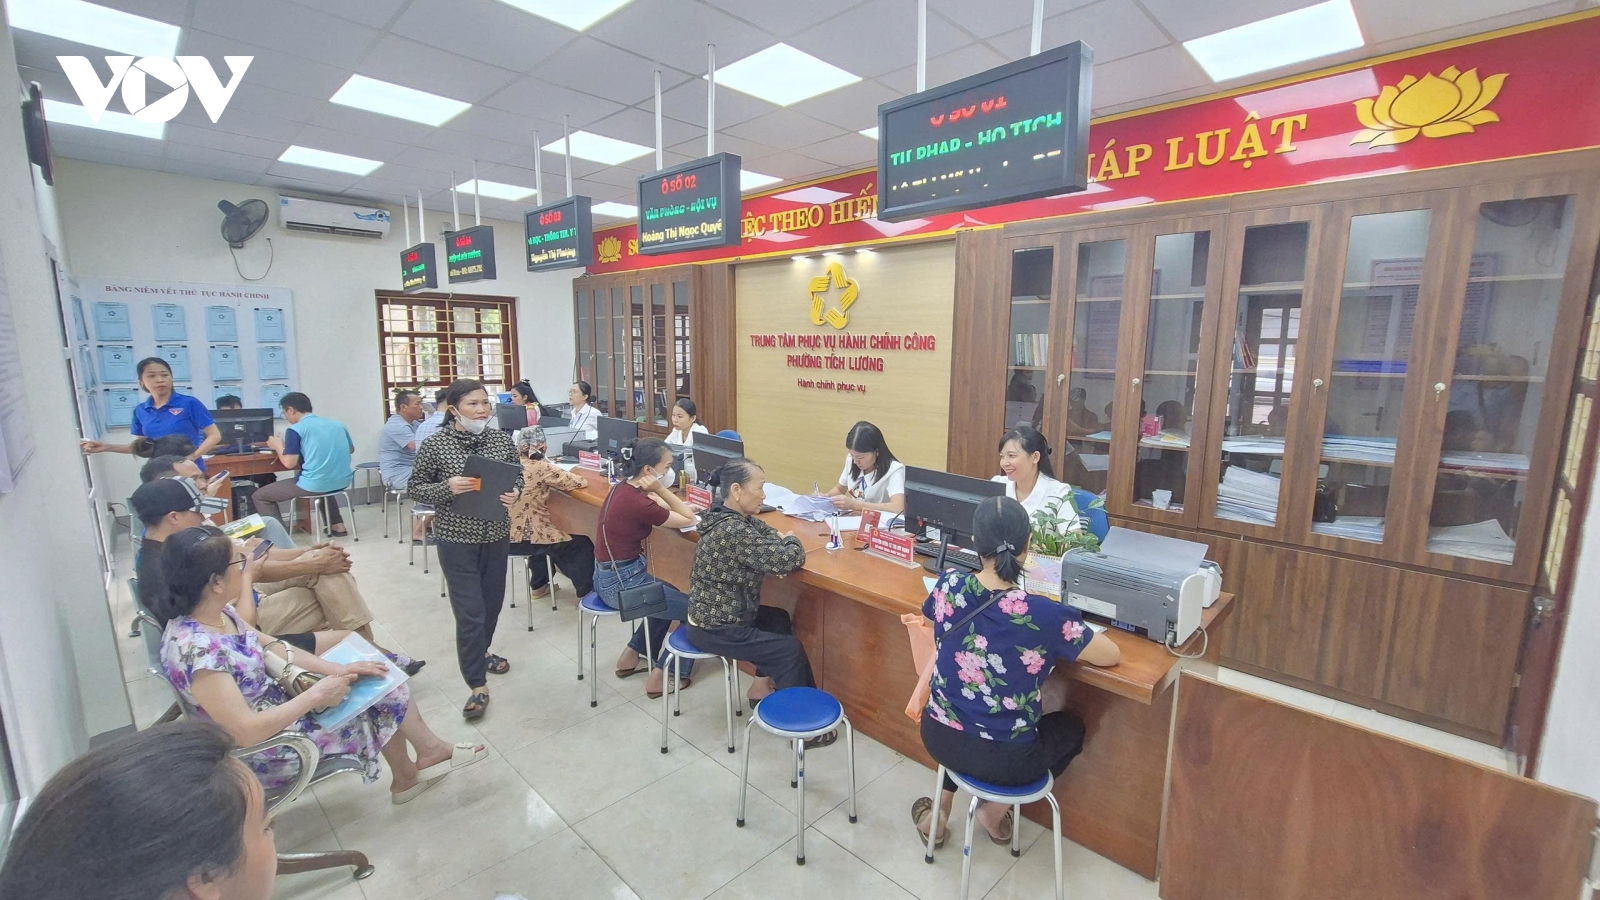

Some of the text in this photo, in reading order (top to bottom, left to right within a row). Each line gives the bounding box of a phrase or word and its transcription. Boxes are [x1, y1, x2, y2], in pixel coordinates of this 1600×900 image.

[661, 173, 697, 195] Ô SỐ 02
[741, 211, 766, 243] ỆC
[770, 204, 824, 233] THEO
[1164, 110, 1308, 172] LUẬT
[706, 196, 718, 209] VỤ
[665, 226, 678, 241] Thị
[678, 225, 699, 239] Ngọc
[105, 284, 132, 293] BẢNG
[134, 286, 158, 294] NIÊM
[160, 286, 177, 295] YẾT
[200, 290, 217, 298] TỤC
[750, 331, 936, 352] TRUNG TÂM PHỤC VỤ HÀNH CHÍNH CÔNG
[787, 352, 884, 372] PHƯỜNG TÍCH LƯƠNG
[797, 377, 867, 395] Hành chính phục vụ
